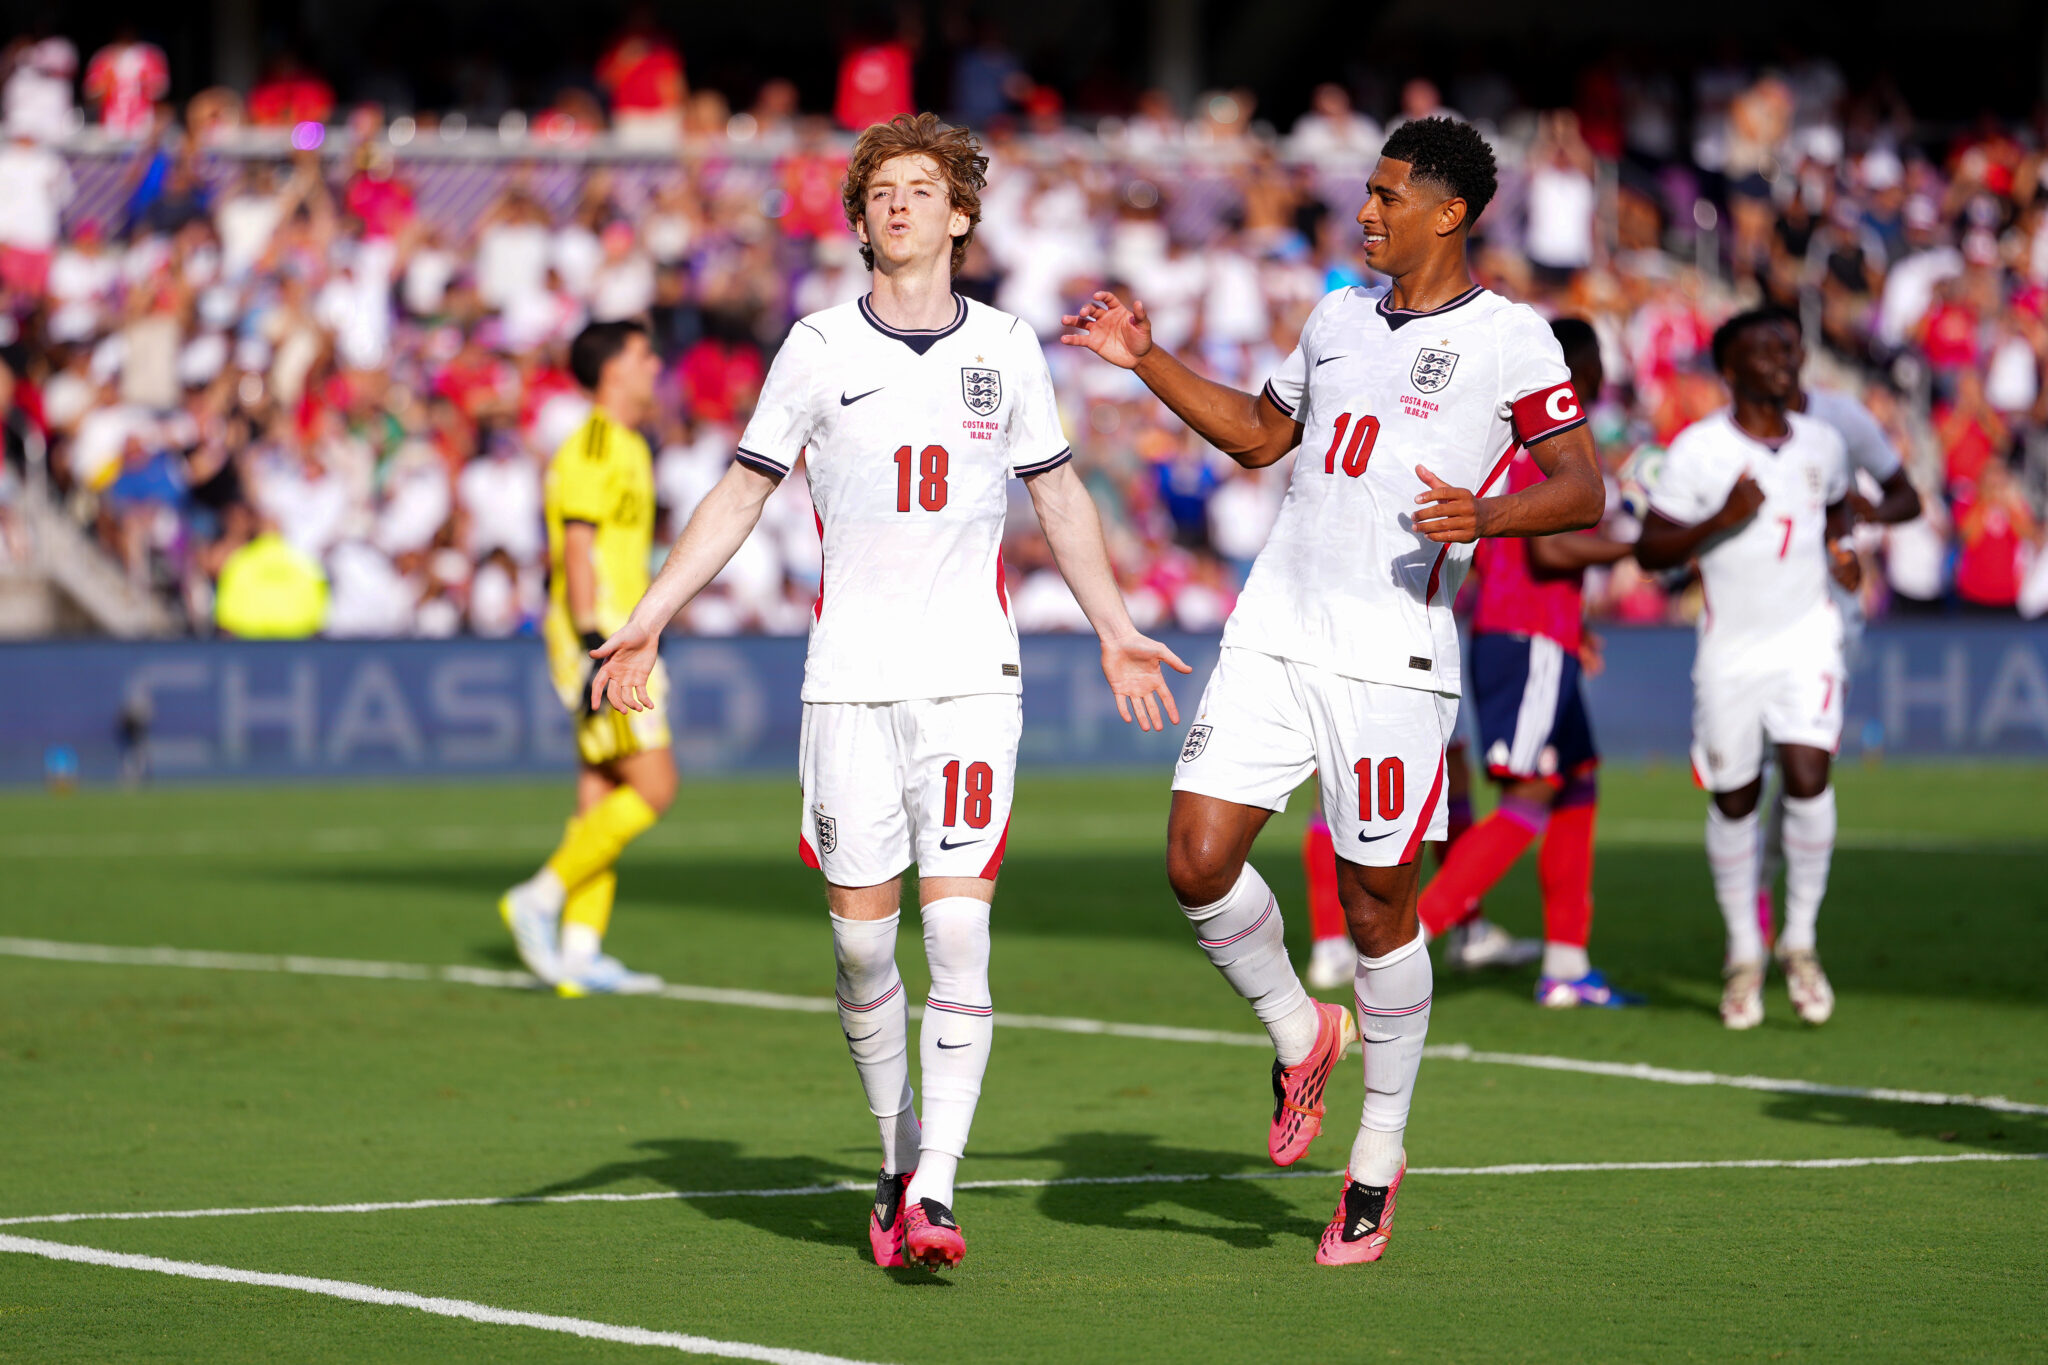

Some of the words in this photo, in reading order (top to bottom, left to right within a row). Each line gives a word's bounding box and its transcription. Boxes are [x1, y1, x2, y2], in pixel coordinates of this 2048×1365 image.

[962, 420, 984, 429] COSTA
[985, 421, 998, 430] RICA
[1400, 395, 1422, 406] COSTA
[1422, 400, 1439, 412] RICA
[1545, 387, 1578, 421] C
[1325, 412, 1380, 478] 10
[894, 445, 949, 512] 18
[1775, 516, 1793, 560] 7
[1820, 672, 1835, 714] 7
[943, 760, 993, 829] 18
[1354, 756, 1405, 822] 10
